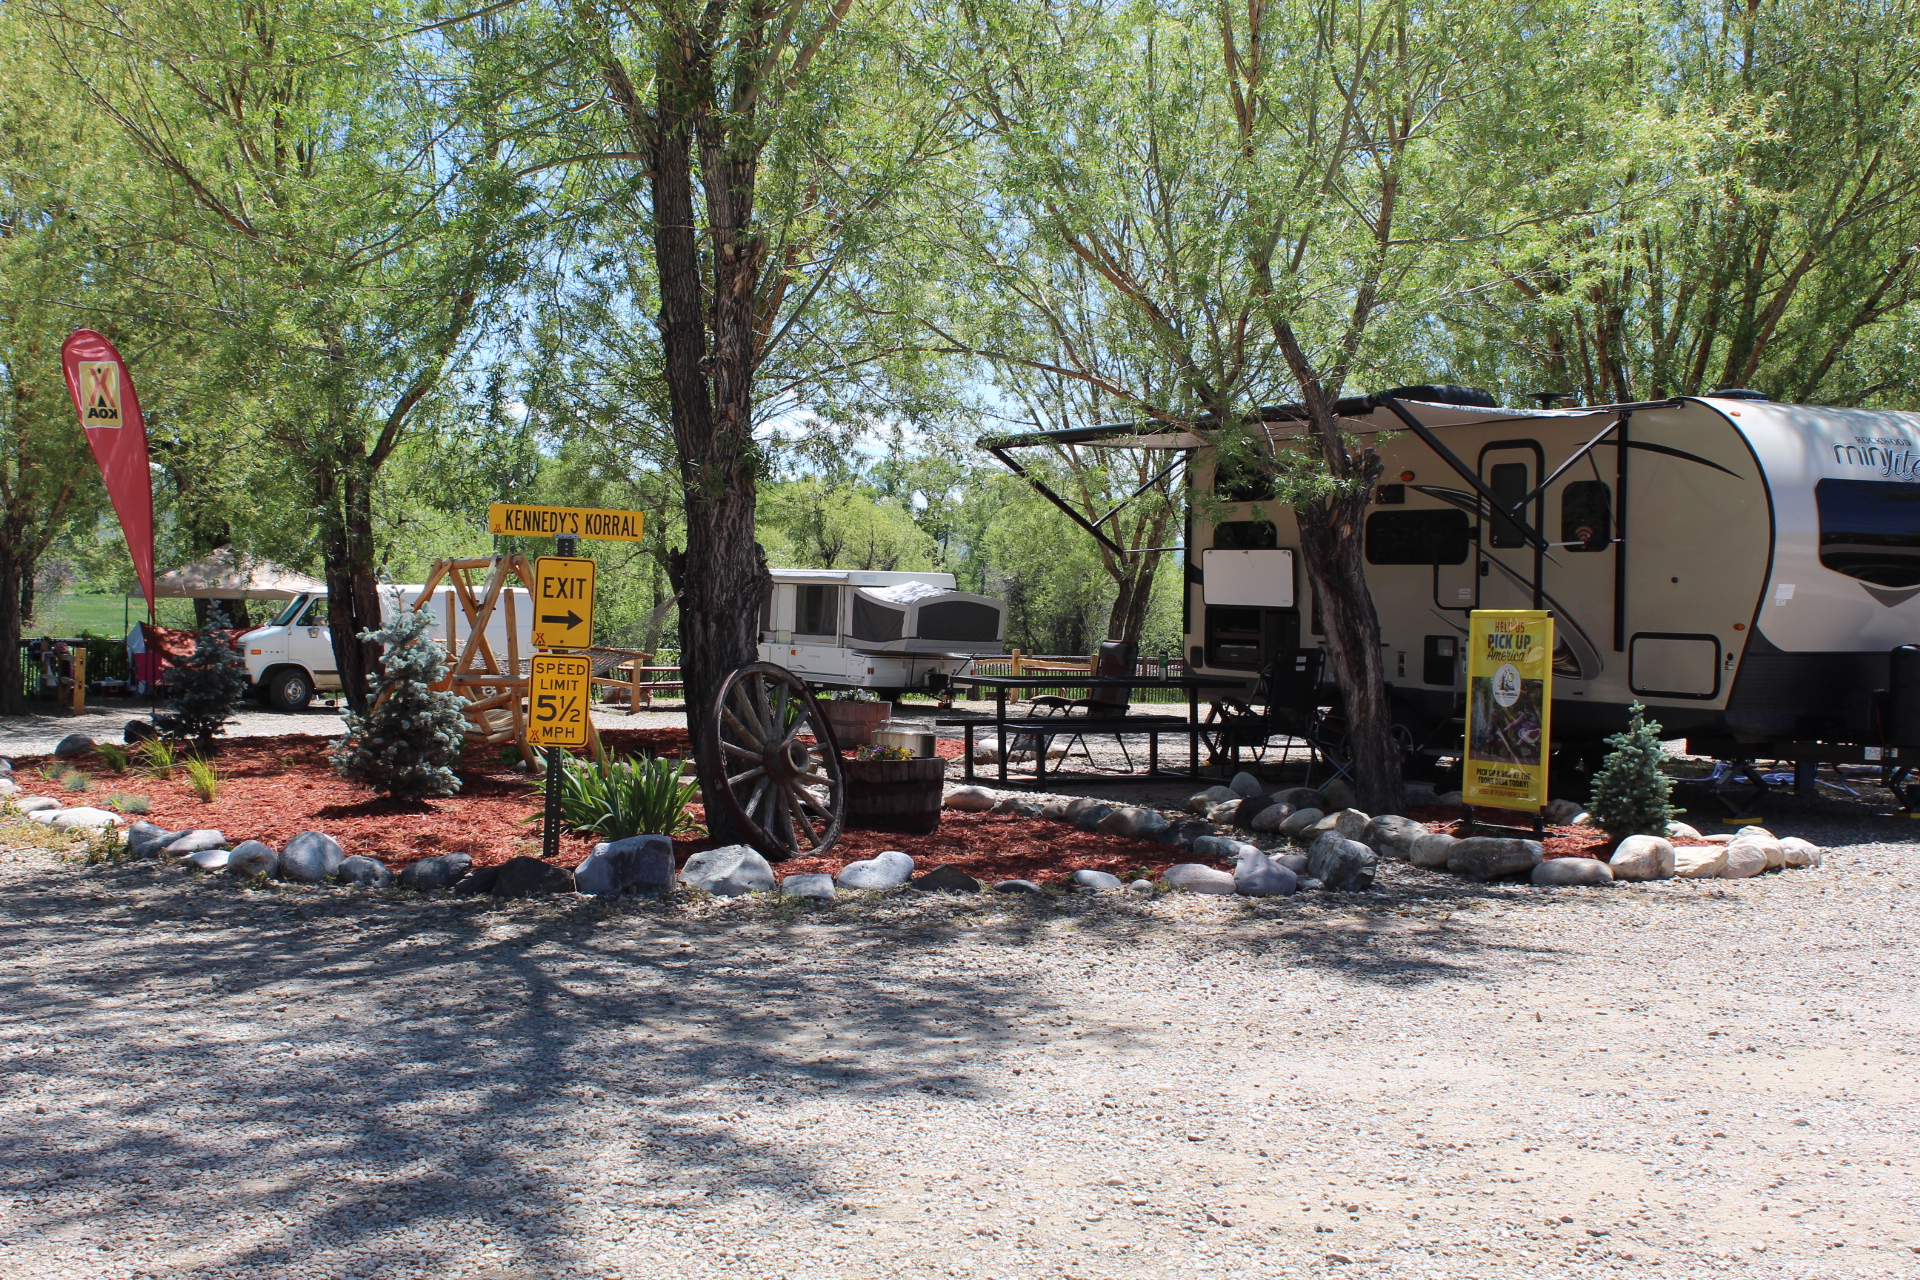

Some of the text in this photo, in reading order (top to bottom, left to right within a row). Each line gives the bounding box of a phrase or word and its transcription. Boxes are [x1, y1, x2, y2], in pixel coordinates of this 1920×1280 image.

[1854, 436, 1912, 446] ROCKWOOD
[505, 509, 638, 537] KENNEDY'S KORRAL
[543, 576, 587, 600] EXIT
[1494, 621, 1525, 633] HELP US
[1487, 633, 1531, 650] PICK UP
[1486, 646, 1532, 662] America!
[536, 662, 586, 676] SPEED
[540, 679, 580, 691] LIMIT
[542, 726, 575, 739] MPH
[1509, 779, 1529, 788] TODAY!
